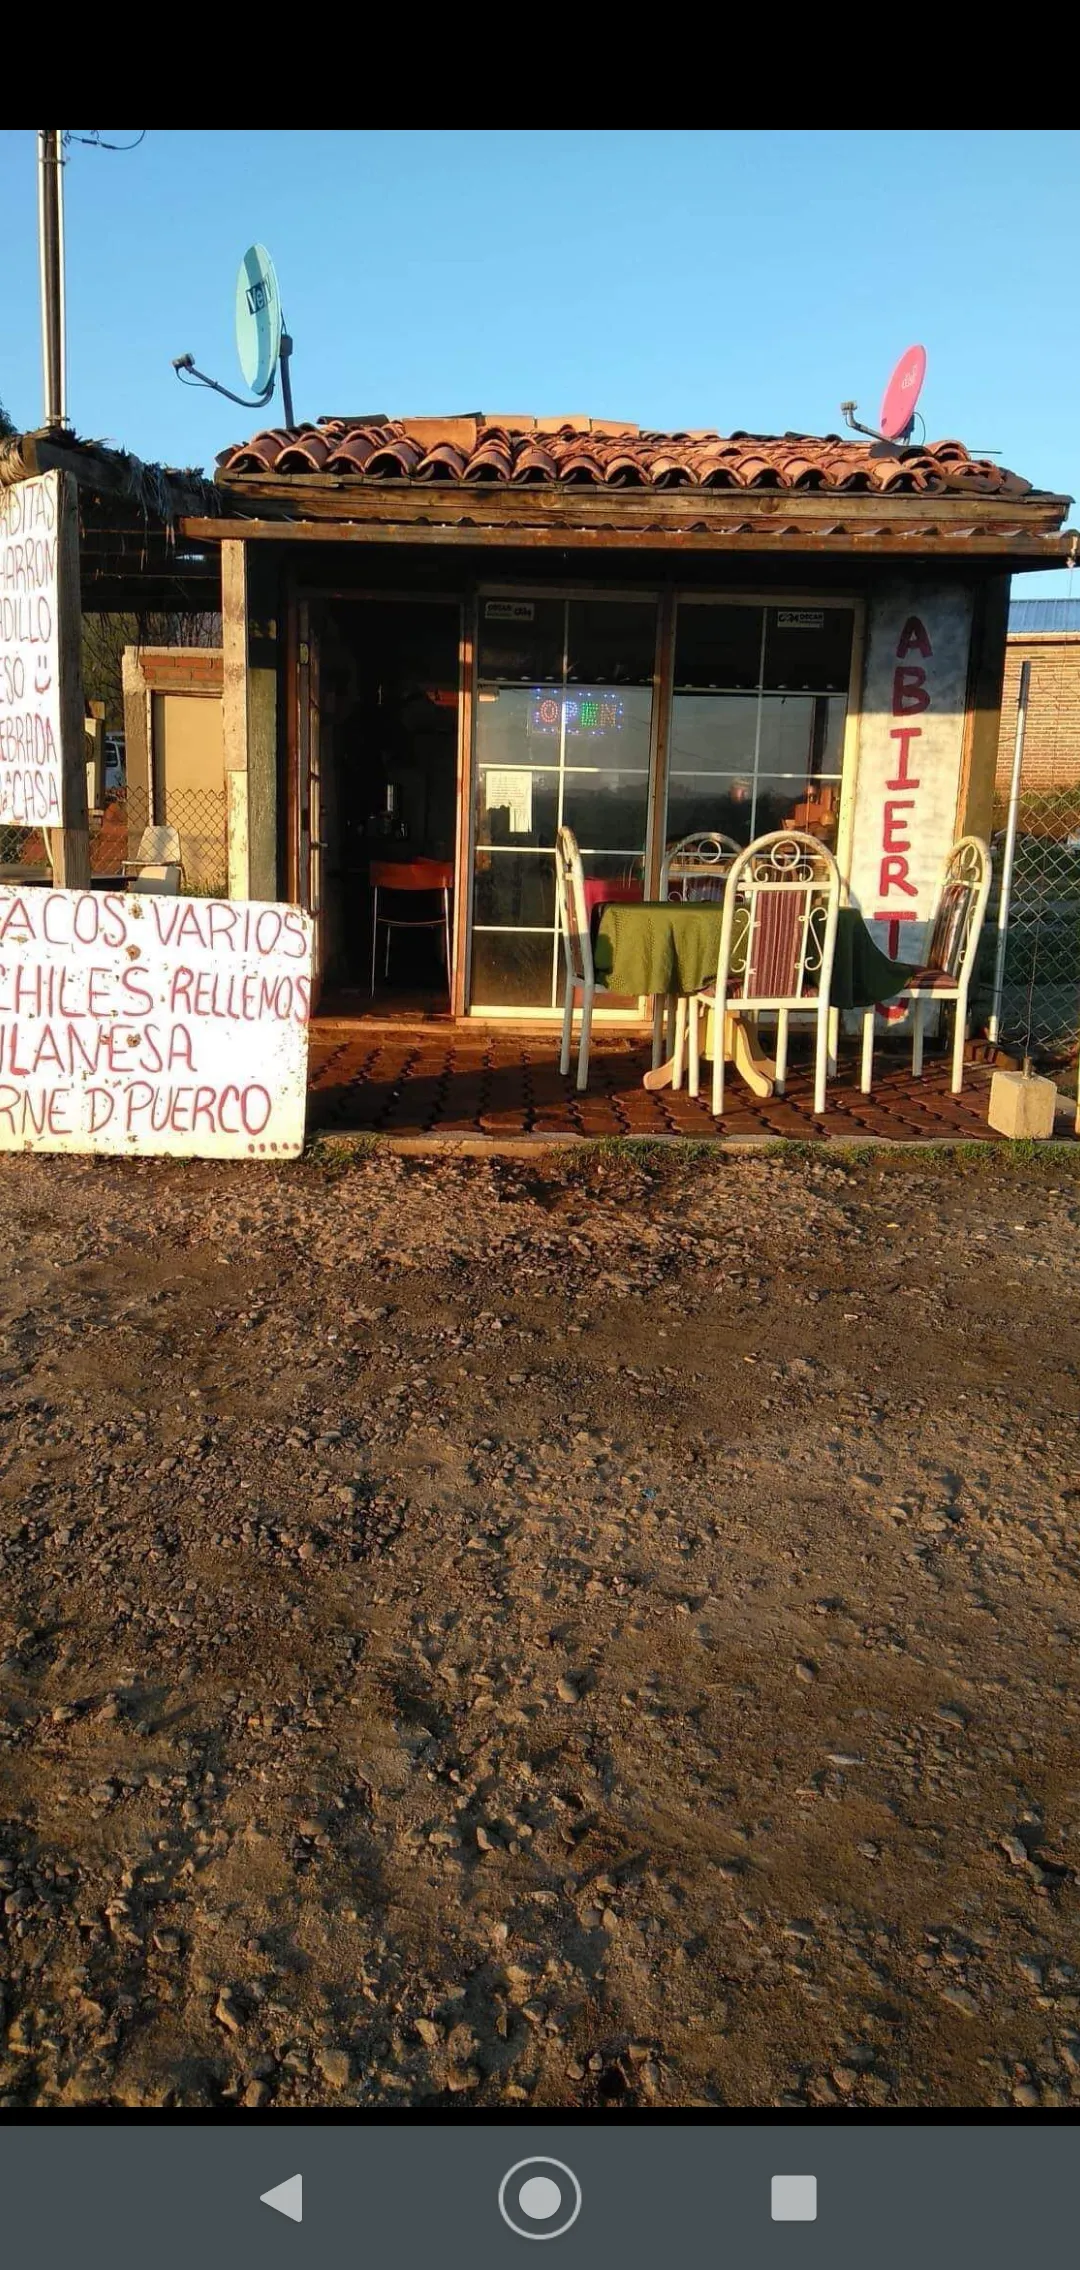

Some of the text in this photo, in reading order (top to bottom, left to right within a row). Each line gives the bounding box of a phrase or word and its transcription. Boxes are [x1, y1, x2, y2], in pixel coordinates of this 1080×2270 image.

[540, 699, 617, 727] OPEN
[153, 901, 307, 959] VARIOS
[170, 965, 310, 1023] RELLENOS
